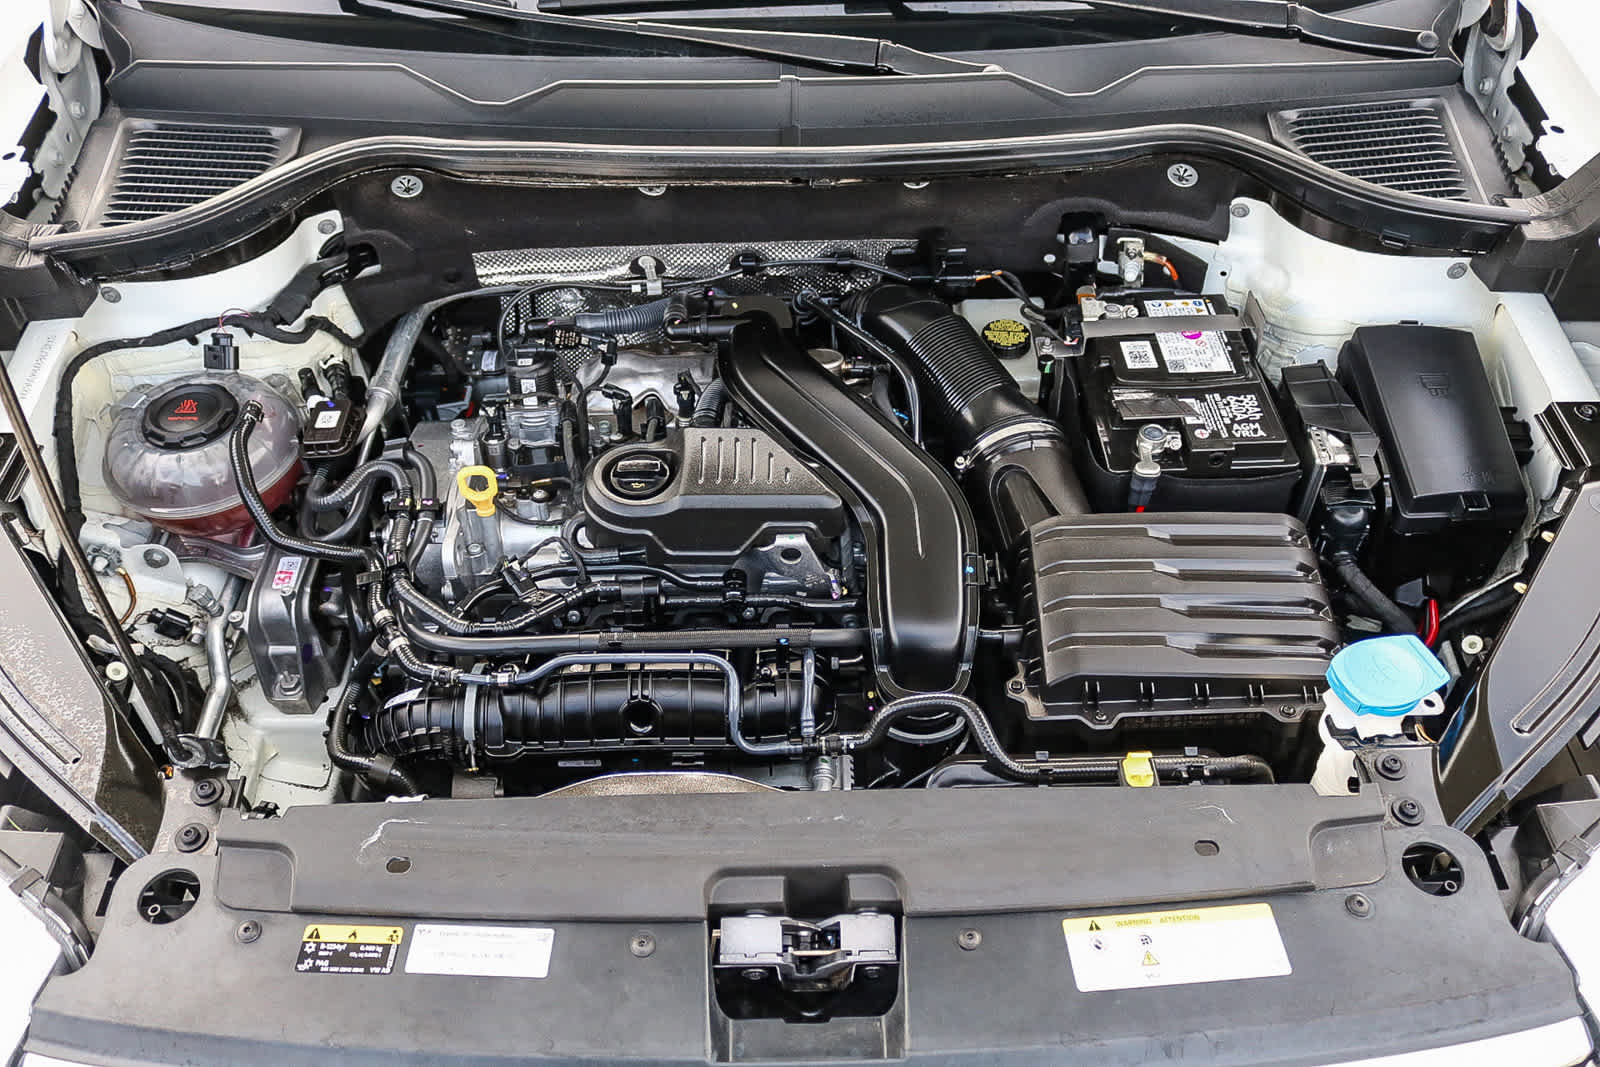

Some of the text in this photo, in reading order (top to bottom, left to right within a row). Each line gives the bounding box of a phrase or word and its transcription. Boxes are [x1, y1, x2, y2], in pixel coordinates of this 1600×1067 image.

[1241, 394, 1263, 420] 58Ah
[1233, 422, 1260, 432] AGM
[1231, 430, 1267, 438] VRLA
[1160, 914, 1200, 923] ATTENTION
